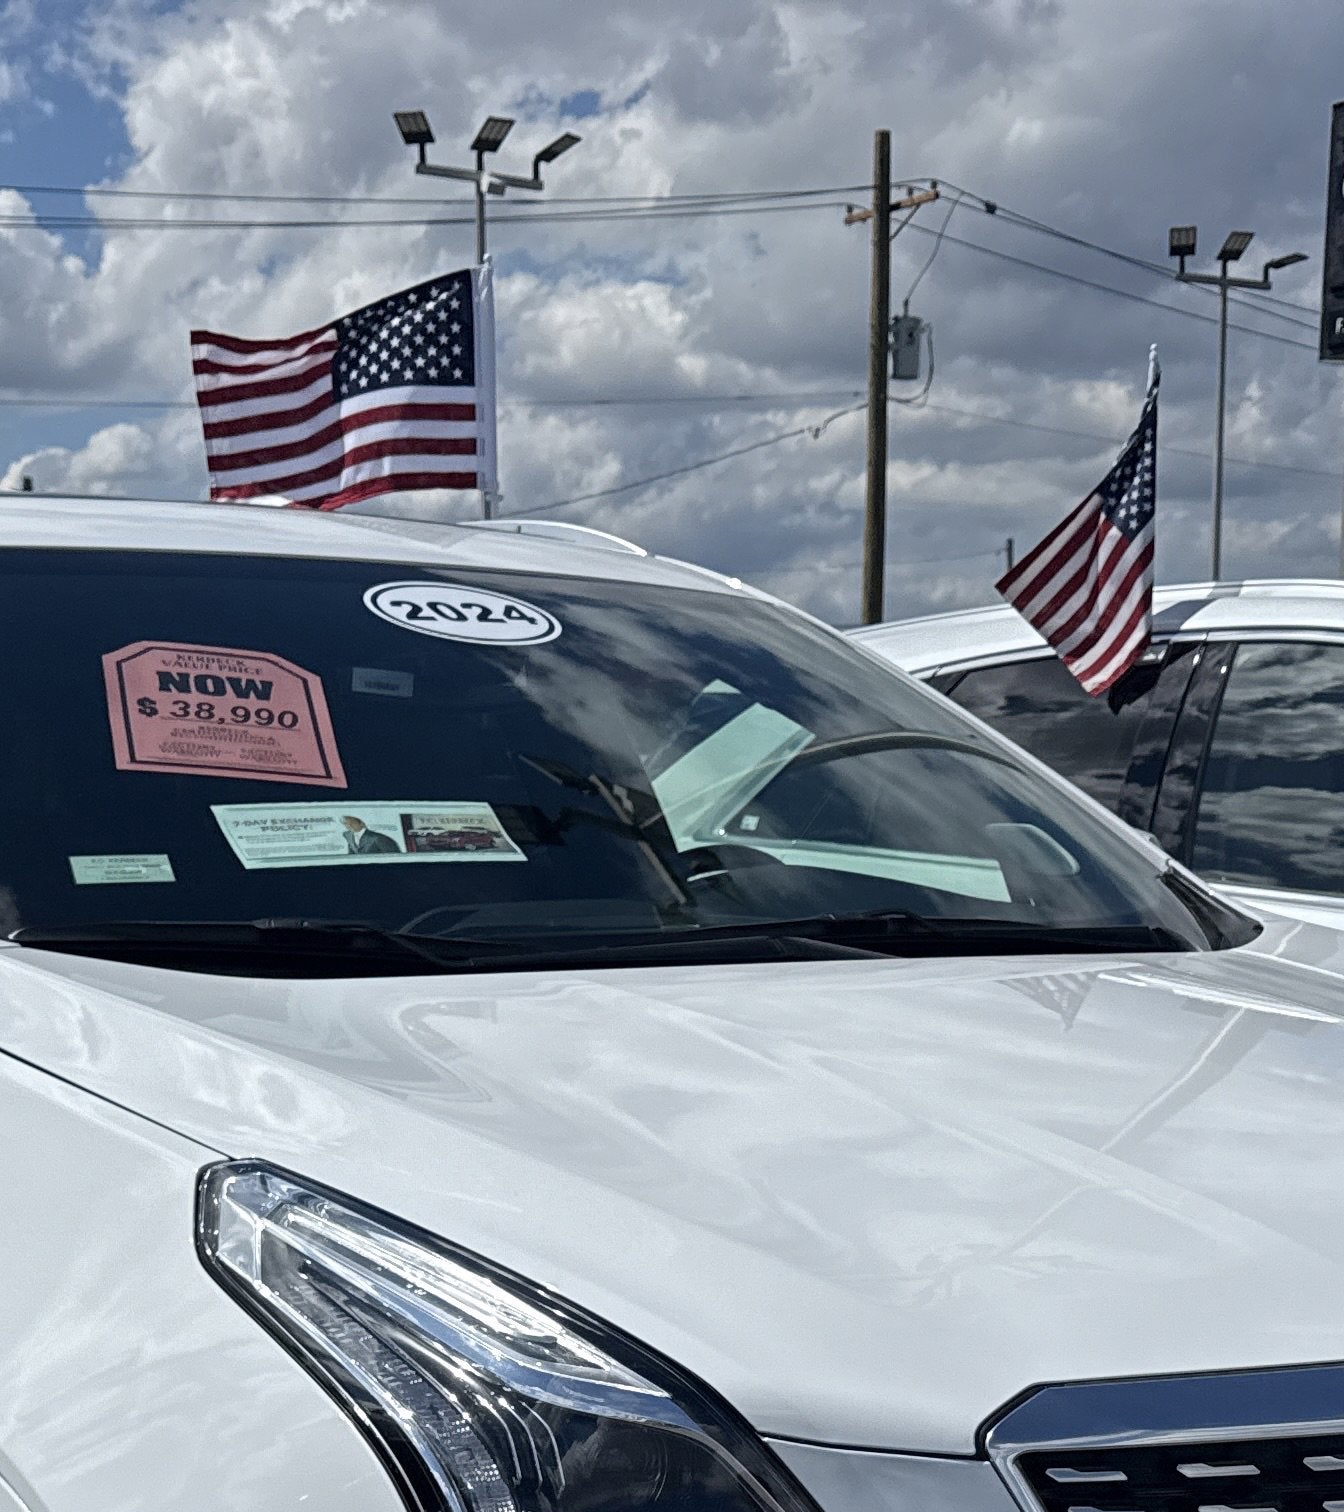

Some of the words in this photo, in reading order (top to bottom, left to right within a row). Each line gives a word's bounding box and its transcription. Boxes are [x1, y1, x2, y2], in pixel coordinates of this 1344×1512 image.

[390, 600, 538, 625] 2024
[157, 671, 274, 702] NOW
[136, 697, 159, 718] $
[169, 700, 299, 729] 38,990
